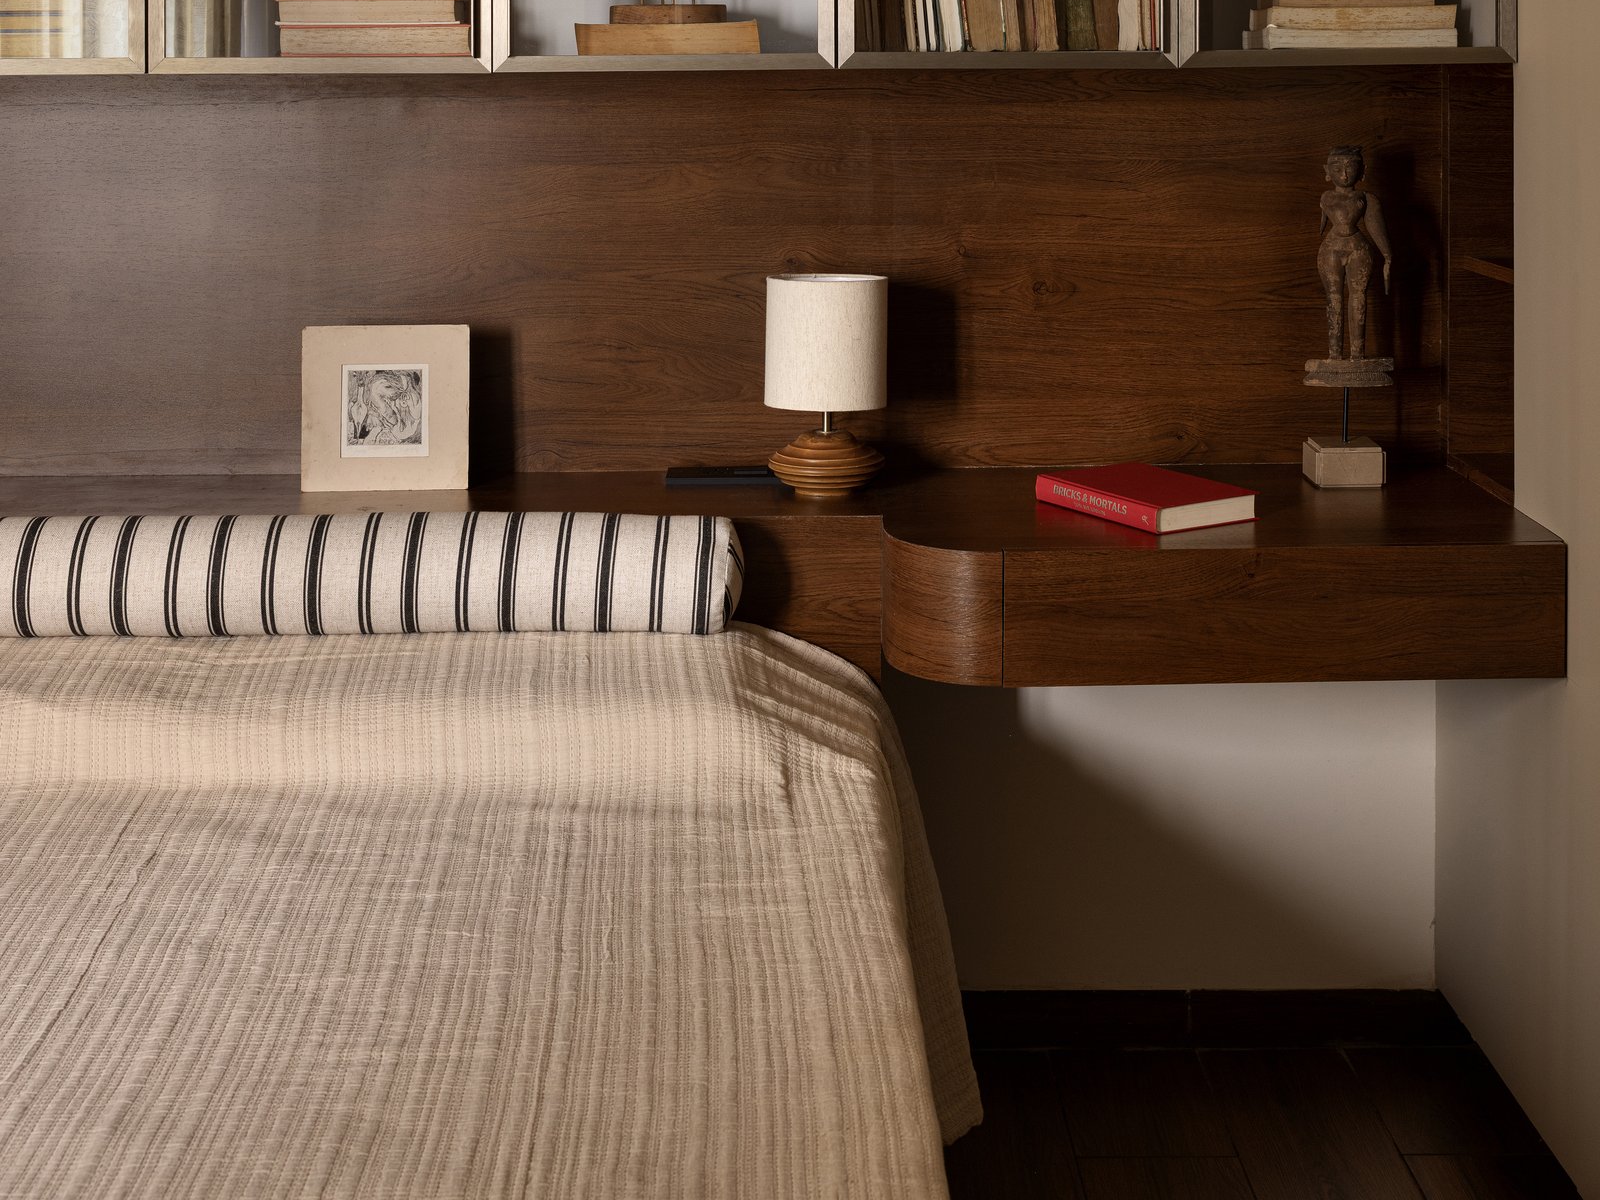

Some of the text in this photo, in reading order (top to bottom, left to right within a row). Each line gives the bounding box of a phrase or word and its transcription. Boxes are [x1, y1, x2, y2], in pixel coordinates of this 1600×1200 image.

[1053, 484, 1081, 501] BRICKS
[1082, 493, 1088, 503] &
[1089, 495, 1127, 515] MORTALS
